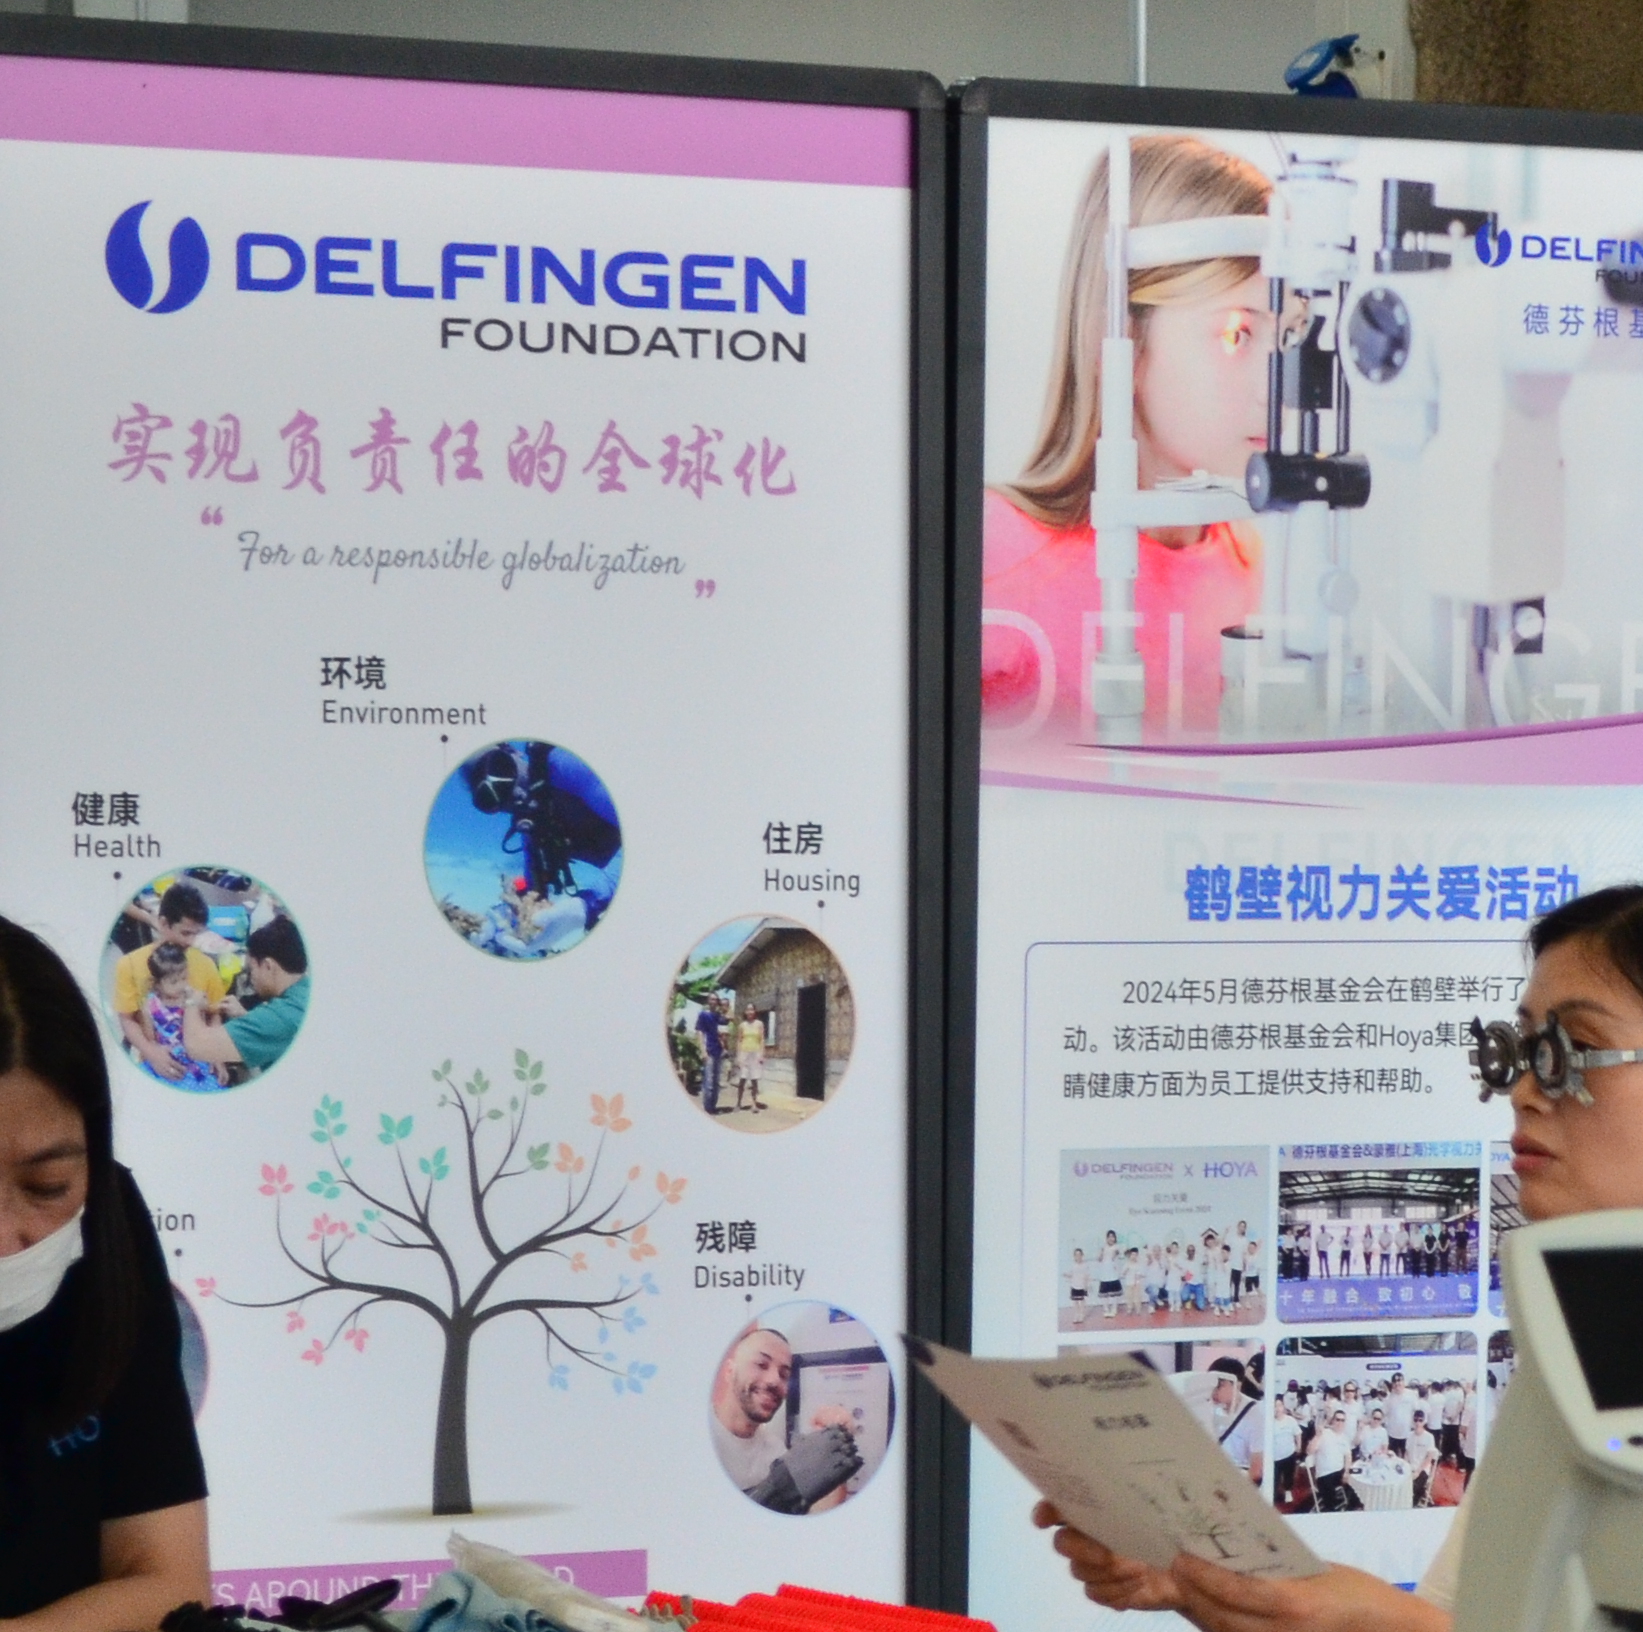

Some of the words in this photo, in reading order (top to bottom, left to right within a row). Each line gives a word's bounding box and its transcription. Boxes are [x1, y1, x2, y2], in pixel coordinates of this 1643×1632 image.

[236, 232, 807, 316] DELFINGEN
[441, 318, 807, 363] FOUNDATION
[107, 402, 798, 500] 实现负责任的全球化
[237, 530, 296, 572] For
[303, 546, 324, 567] a
[330, 537, 494, 585] responsible
[501, 541, 686, 591] globalization
[320, 656, 387, 692] 环境
[321, 700, 487, 726] Environment
[71, 792, 140, 828] 健康
[73, 834, 162, 860] Health
[763, 820, 825, 858] 住房
[764, 868, 861, 897] Housing
[1185, 864, 1579, 921] 鹤壁视力关爱活动
[1063, 1068, 1433, 1099] 睛健康方面为员工提供支持和帮助。
[1203, 1161, 1258, 1178] HOYA
[695, 1220, 758, 1254] 残障
[694, 1263, 806, 1291] Disability
